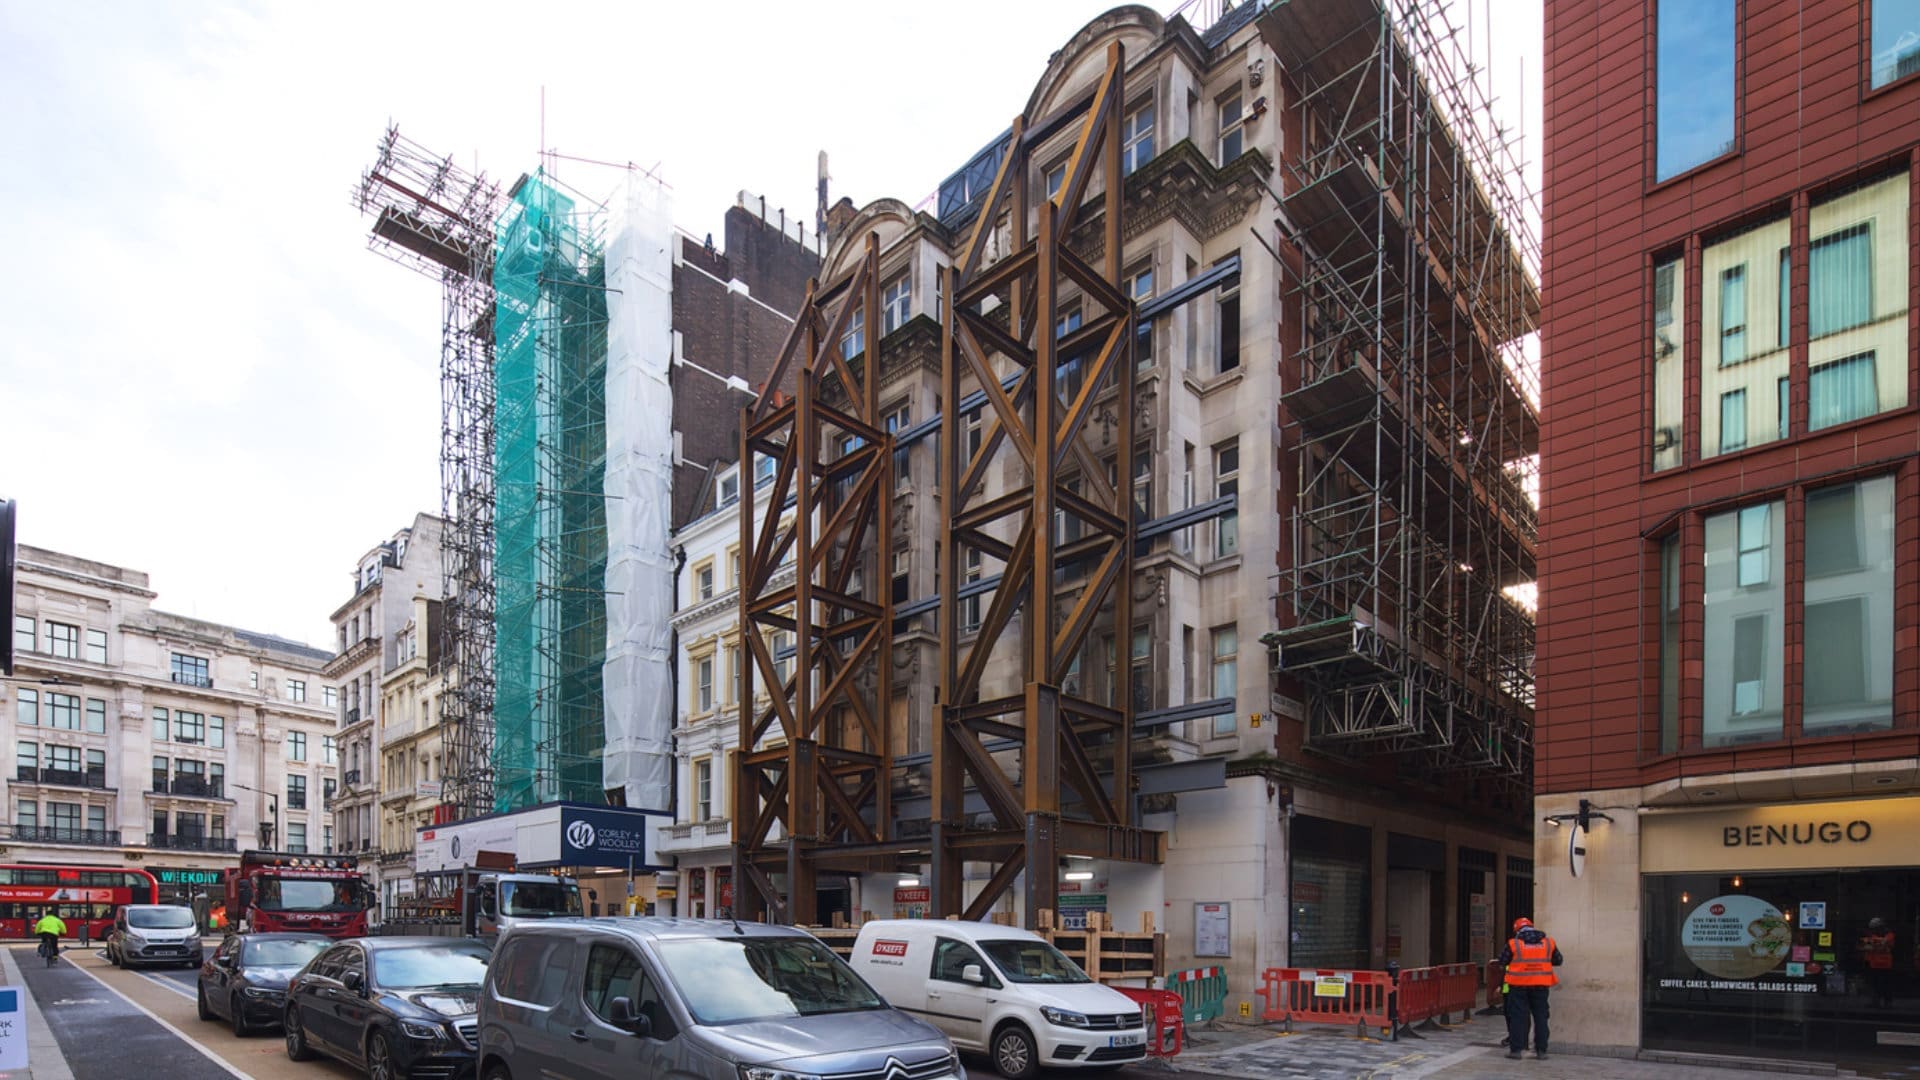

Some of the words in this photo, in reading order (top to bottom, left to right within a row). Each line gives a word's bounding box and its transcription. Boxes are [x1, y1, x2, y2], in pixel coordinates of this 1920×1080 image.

[597, 829, 631, 839] CORLEY
[1723, 820, 1872, 847] BENUGO
[599, 839, 641, 849] WOOLLEY
[896, 890, 928, 901] O'KEEFE
[875, 944, 905, 954] O'KEEFE
[1660, 979, 1685, 988] COFFEE,
[1686, 980, 1709, 989] CAKES,
[1710, 980, 1757, 991] SANDWICHES,
[1758, 982, 1785, 991] SALADS
[1793, 983, 1818, 993] SOUPS
